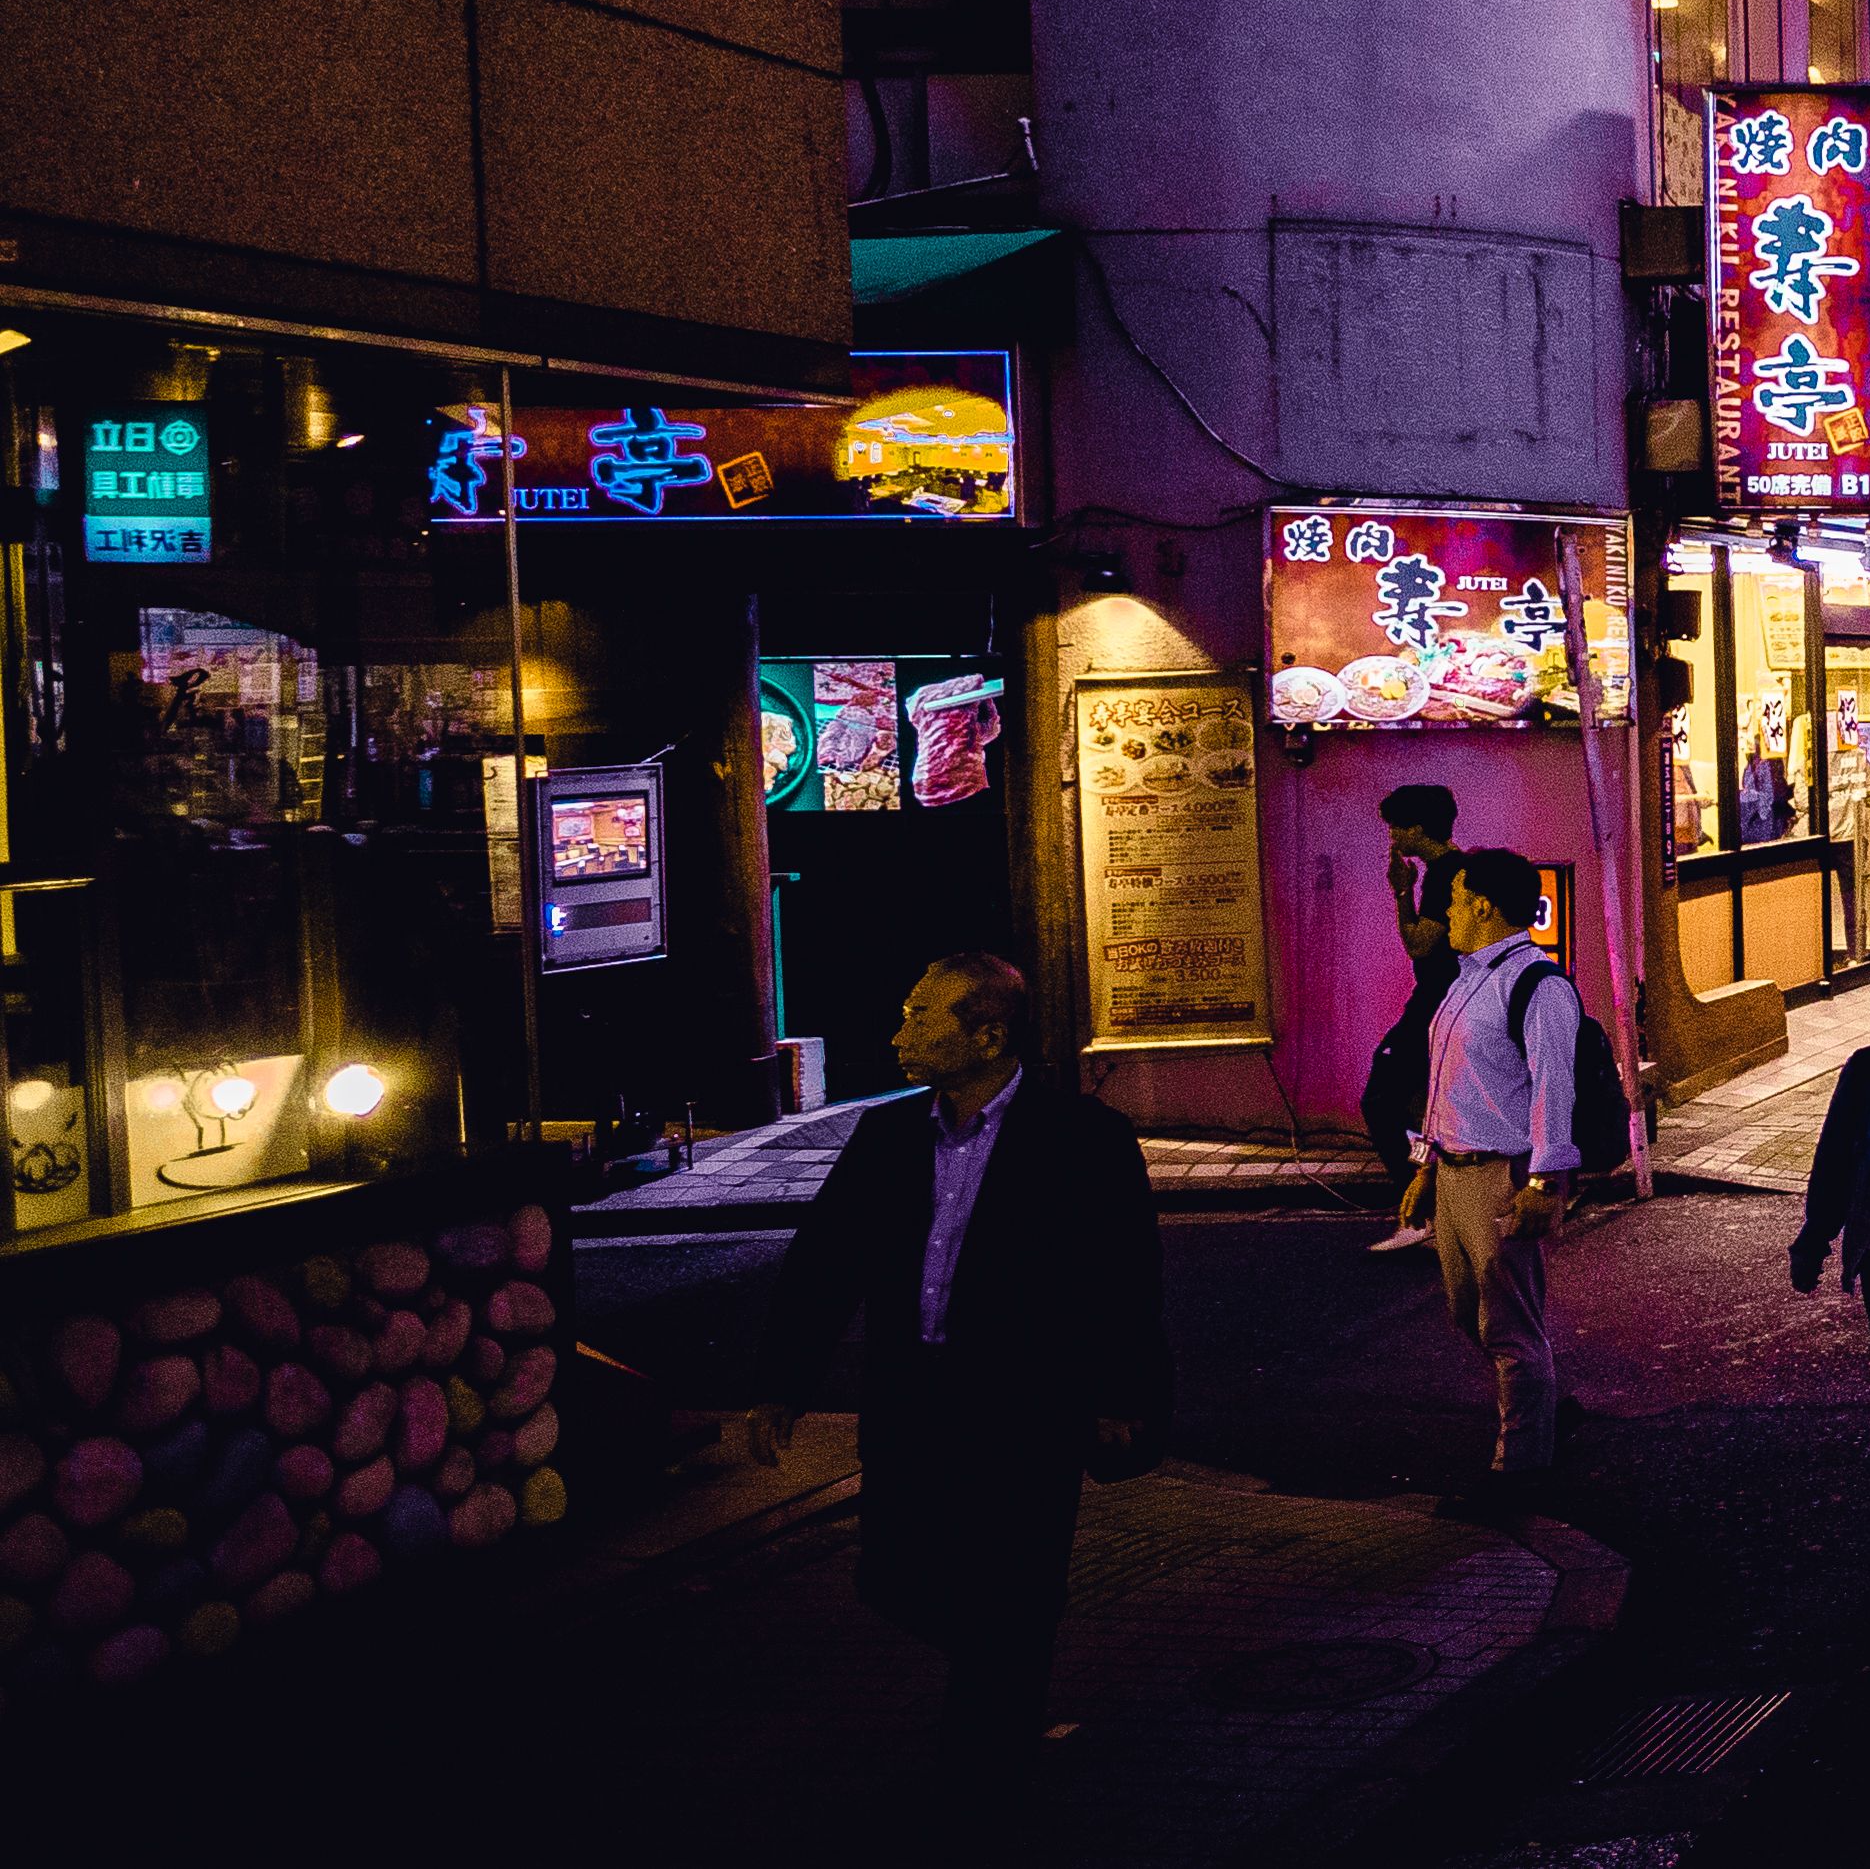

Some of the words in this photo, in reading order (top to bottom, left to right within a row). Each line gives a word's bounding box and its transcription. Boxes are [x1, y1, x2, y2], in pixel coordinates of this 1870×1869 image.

[1731, 110, 1867, 174] 焼肉
[1716, 287, 1742, 506] RESTAURANT
[1767, 442, 1829, 461] JUTEI
[1748, 474, 1832, 496] 50席完備
[1841, 474, 1870, 496] B1
[1284, 515, 1395, 562] 焼肉
[1456, 576, 1508, 591] JUTEI
